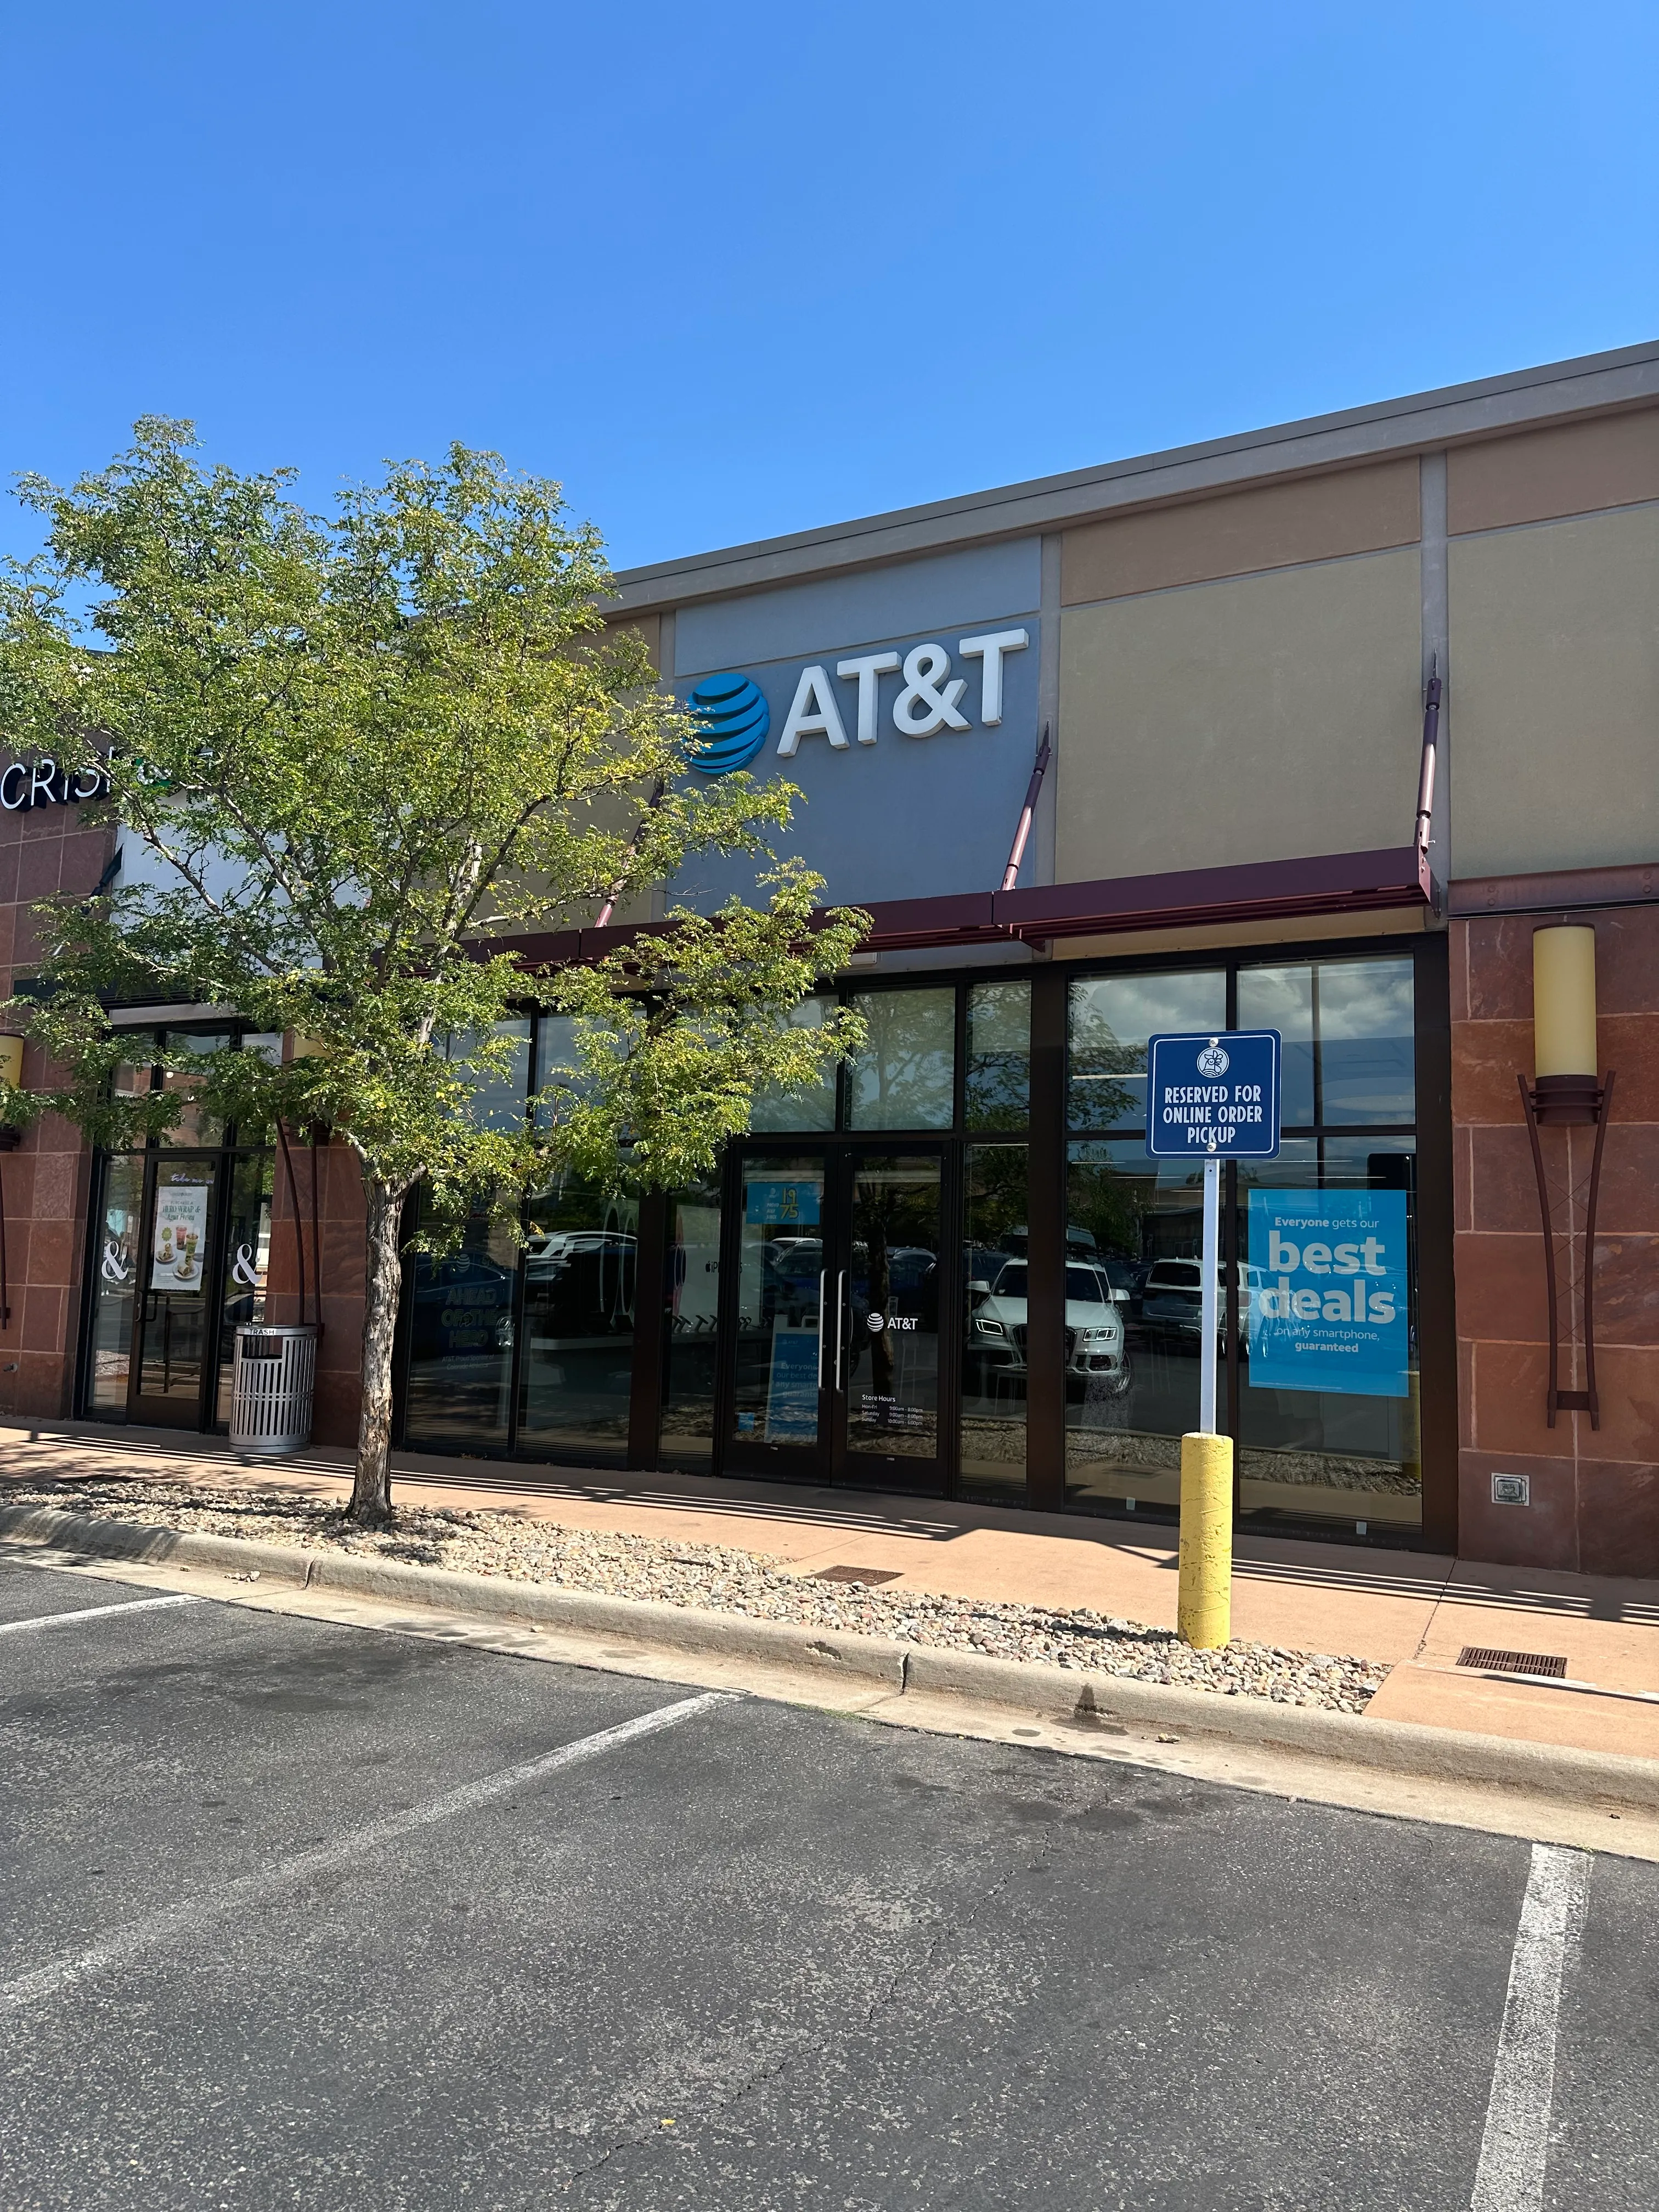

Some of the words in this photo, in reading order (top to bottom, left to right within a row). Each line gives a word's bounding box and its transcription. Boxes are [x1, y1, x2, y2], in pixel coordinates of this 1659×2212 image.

[776, 628, 1029, 758] AT&T
[1165, 1086, 1228, 1103] RESERVED
[1235, 1085, 1261, 1102] FOR
[1163, 1107, 1211, 1124] ONLINE
[1218, 1105, 1262, 1123] ORDER
[1187, 1126, 1235, 1143] PICKUP
[1274, 1217, 1329, 1229] Everyone
[1332, 1219, 1357, 1230] gets
[1359, 1220, 1379, 1228] our
[1269, 1230, 1387, 1276] best
[445, 1288, 497, 1305] AHEAD
[1259, 1276, 1396, 1324] deals
[887, 1317, 918, 1330] AT&T
[449, 1330, 489, 1348] HERD
[1292, 1329, 1311, 1339] any
[1313, 1329, 1380, 1341] smartphone,
[1295, 1342, 1358, 1353] guaranteed
[790, 1370, 806, 1379] best
[775, 1381, 790, 1389] any
